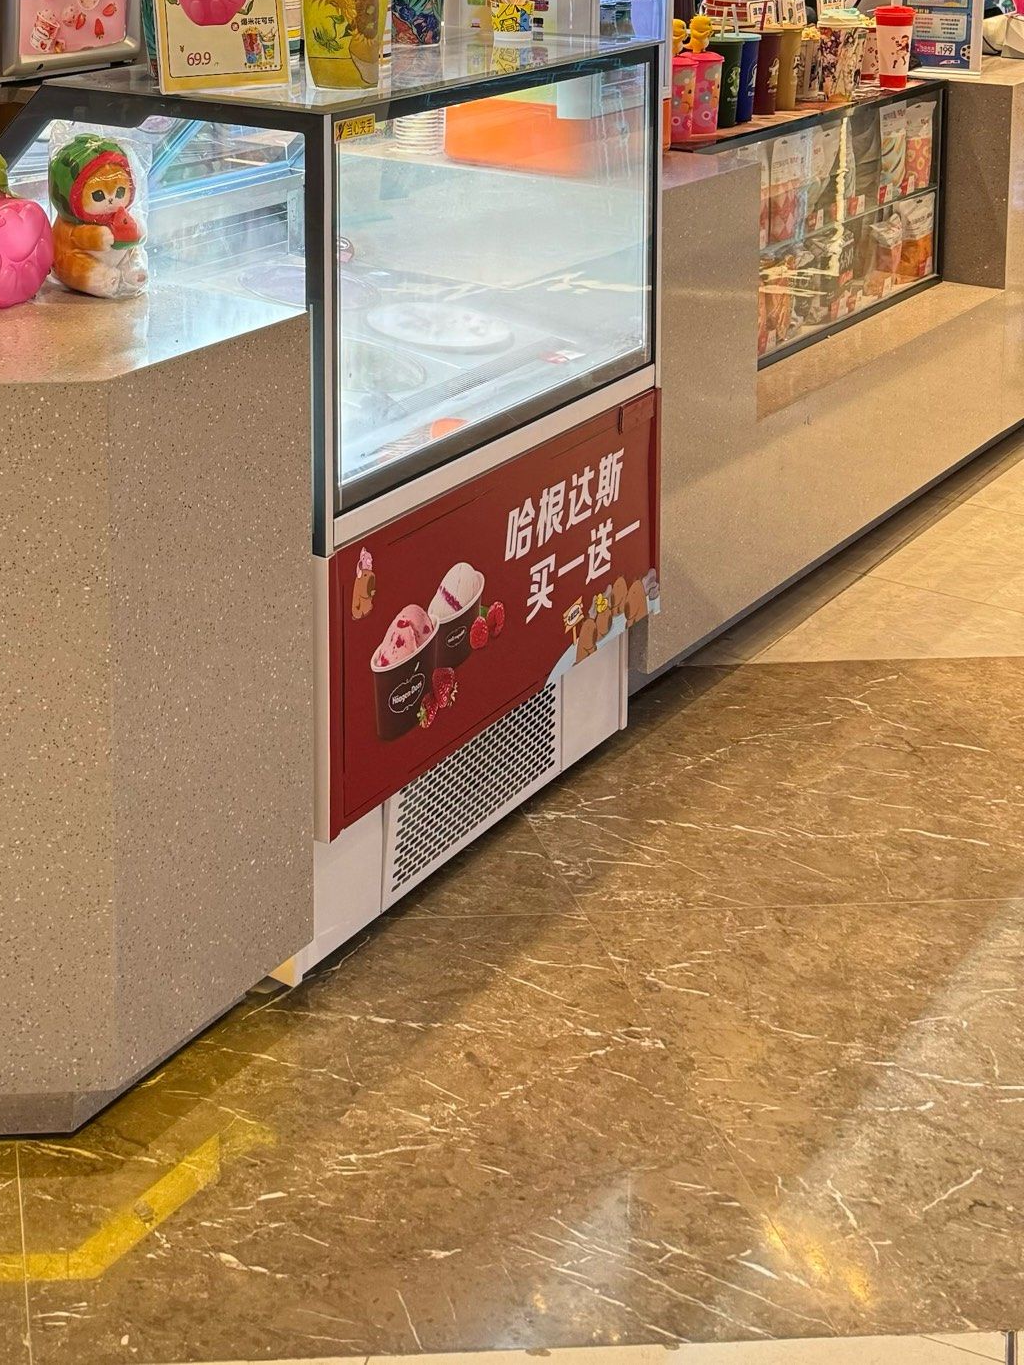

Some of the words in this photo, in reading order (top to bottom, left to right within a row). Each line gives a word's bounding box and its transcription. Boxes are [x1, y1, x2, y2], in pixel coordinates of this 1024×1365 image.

[240, 16, 275, 26] 爆米花可乐
[187, 51, 212, 66] 69.9
[504, 447, 626, 562] 哈根达斯
[525, 518, 641, 625] 买一送一
